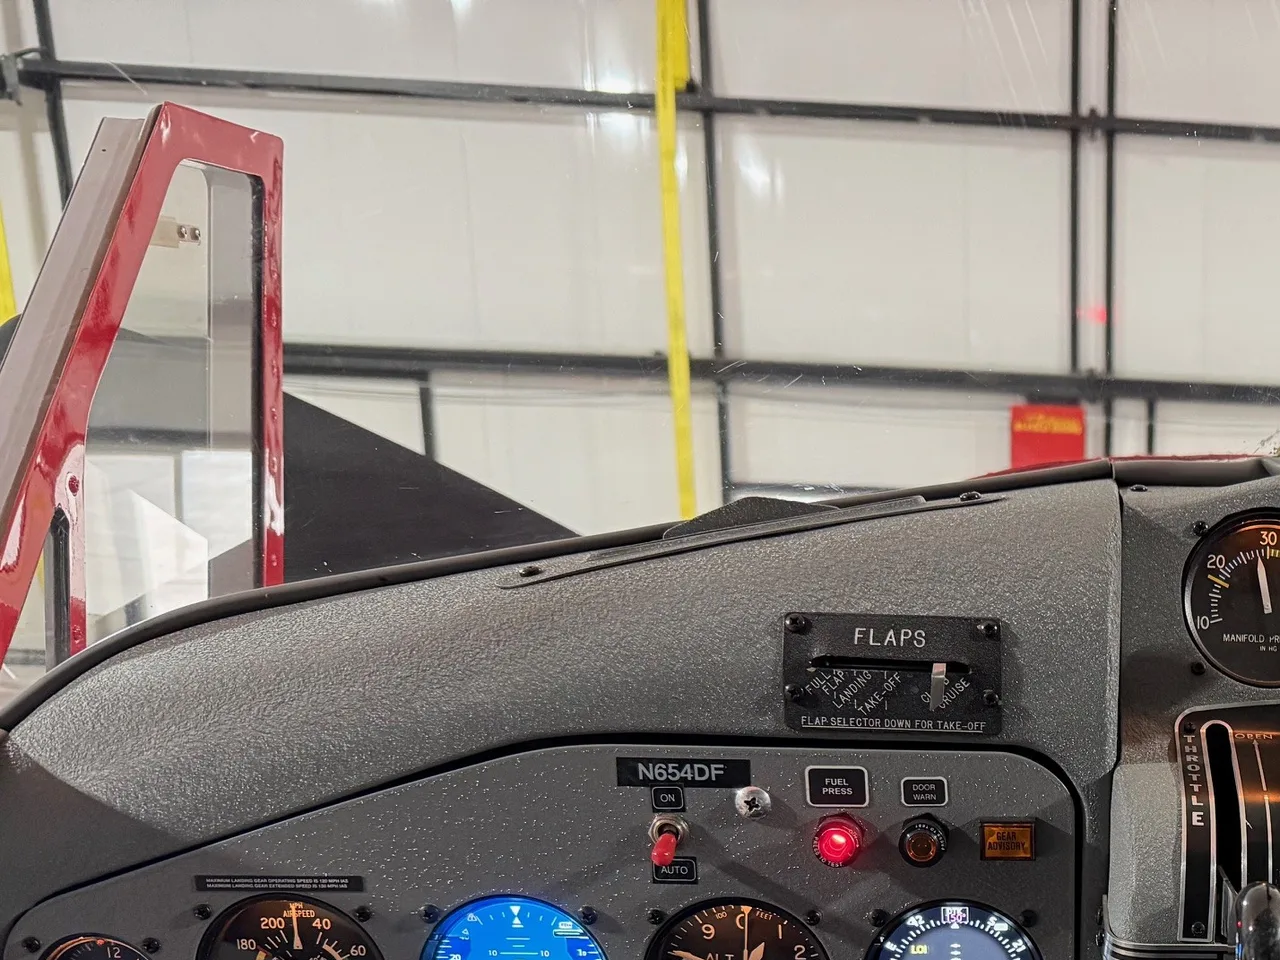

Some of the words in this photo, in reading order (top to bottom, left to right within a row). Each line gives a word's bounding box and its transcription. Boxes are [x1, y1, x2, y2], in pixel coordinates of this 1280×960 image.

[1259, 532, 1277, 545] 30
[1207, 555, 1225, 569] 20
[1197, 615, 1210, 630] 10
[854, 628, 926, 647] FLAPS
[1223, 634, 1265, 644] MANIFOLD
[806, 671, 832, 695] FULL
[822, 671, 846, 695] FLAP
[833, 672, 872, 709] LANDING
[858, 673, 901, 715] TAKE-OFF
[939, 678, 971, 709] CRUISE
[801, 716, 827, 725] FLAP
[831, 718, 881, 727] SELECTOR
[885, 719, 911, 728] DOWN
[915, 720, 933, 729] FOR
[937, 721, 986, 731] TAKE-OFF
[638, 763, 725, 781] N654DF
[825, 777, 849, 786] FUEL
[1183, 735, 1204, 826] THROTTLE
[822, 786, 853, 796] PRESS
[912, 783, 936, 791] DOOR
[660, 793, 675, 802] ON
[913, 793, 937, 801] WARN
[996, 831, 1017, 840] GEAR
[987, 841, 1026, 851] ADVISORY
[661, 865, 688, 875] AUTO
[261, 918, 285, 929] 200
[312, 919, 331, 929] 40
[237, 939, 256, 950] 180
[350, 945, 366, 956] 60
